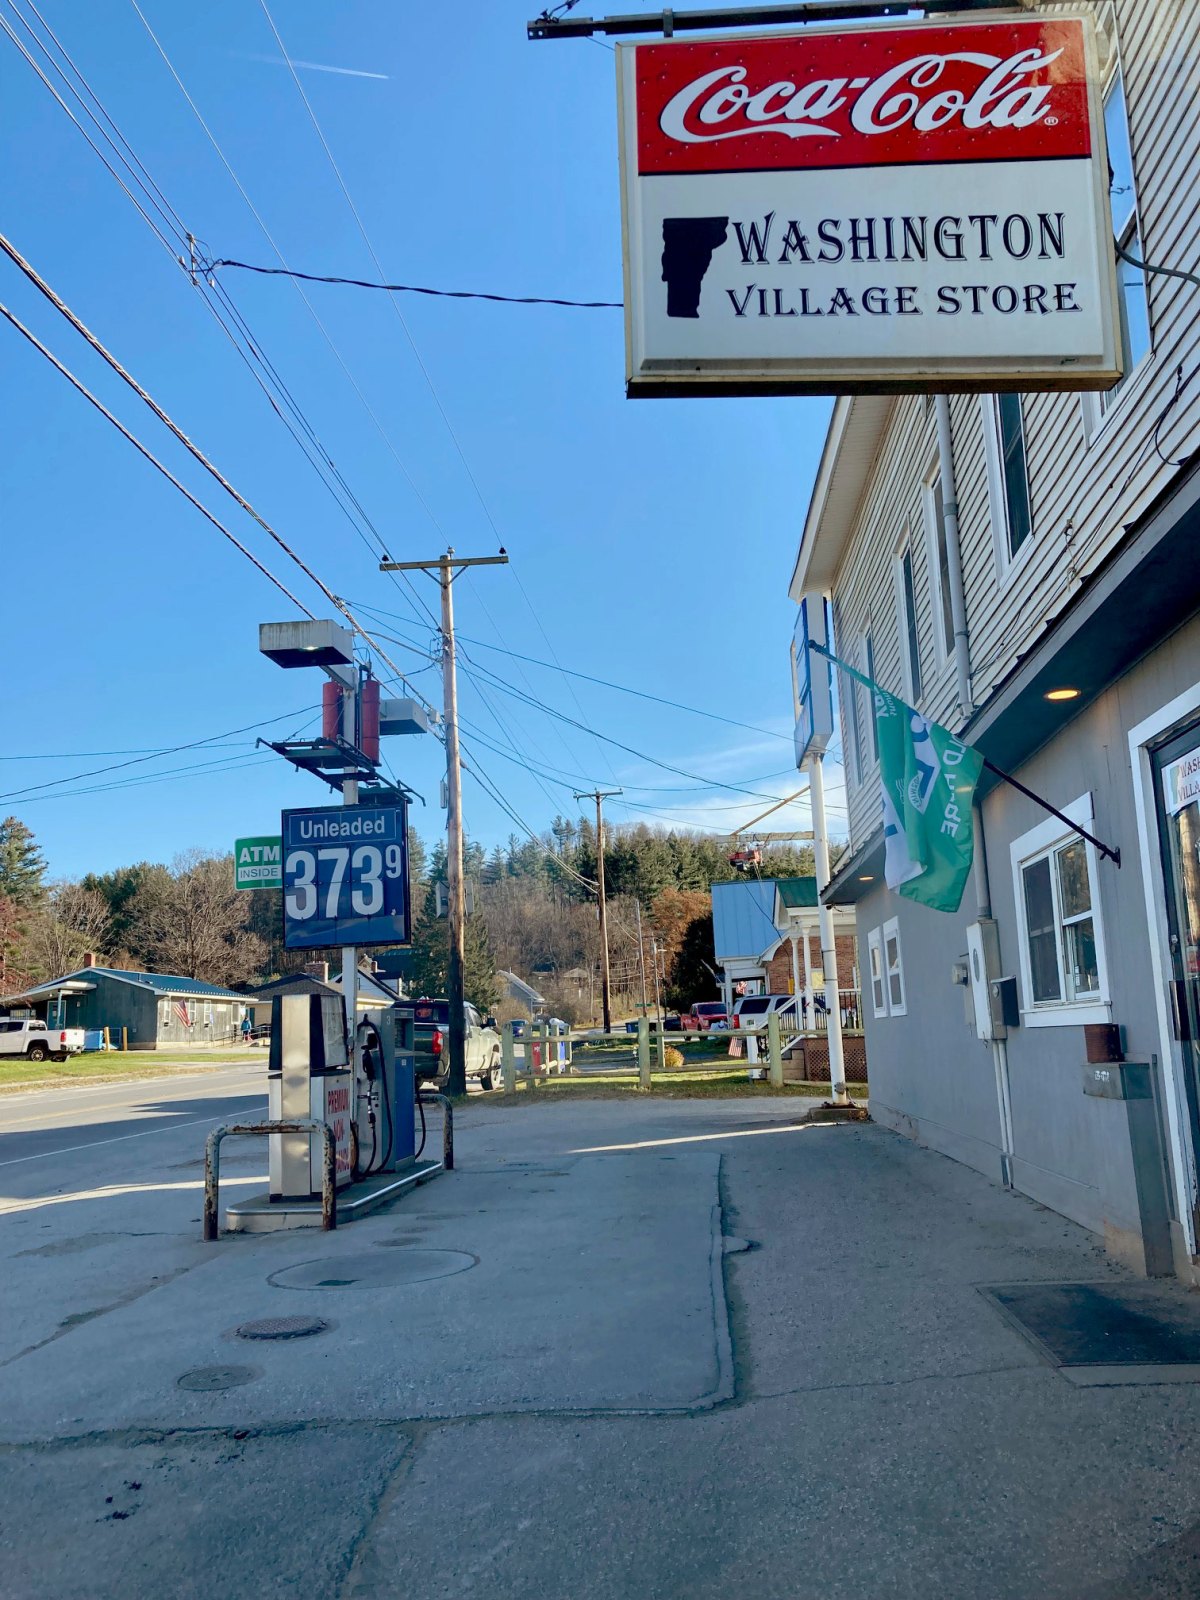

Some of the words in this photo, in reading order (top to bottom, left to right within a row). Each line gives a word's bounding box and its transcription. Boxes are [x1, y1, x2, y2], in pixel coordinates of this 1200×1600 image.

[660, 47, 1064, 143] Coca-Cola
[732, 210, 1065, 265] WASHINGTON
[725, 283, 923, 317] VILLAGE
[937, 283, 1082, 316] STORE
[300, 816, 385, 839] Unleaded
[239, 845, 280, 864] ATM
[240, 867, 279, 879] INSIDE
